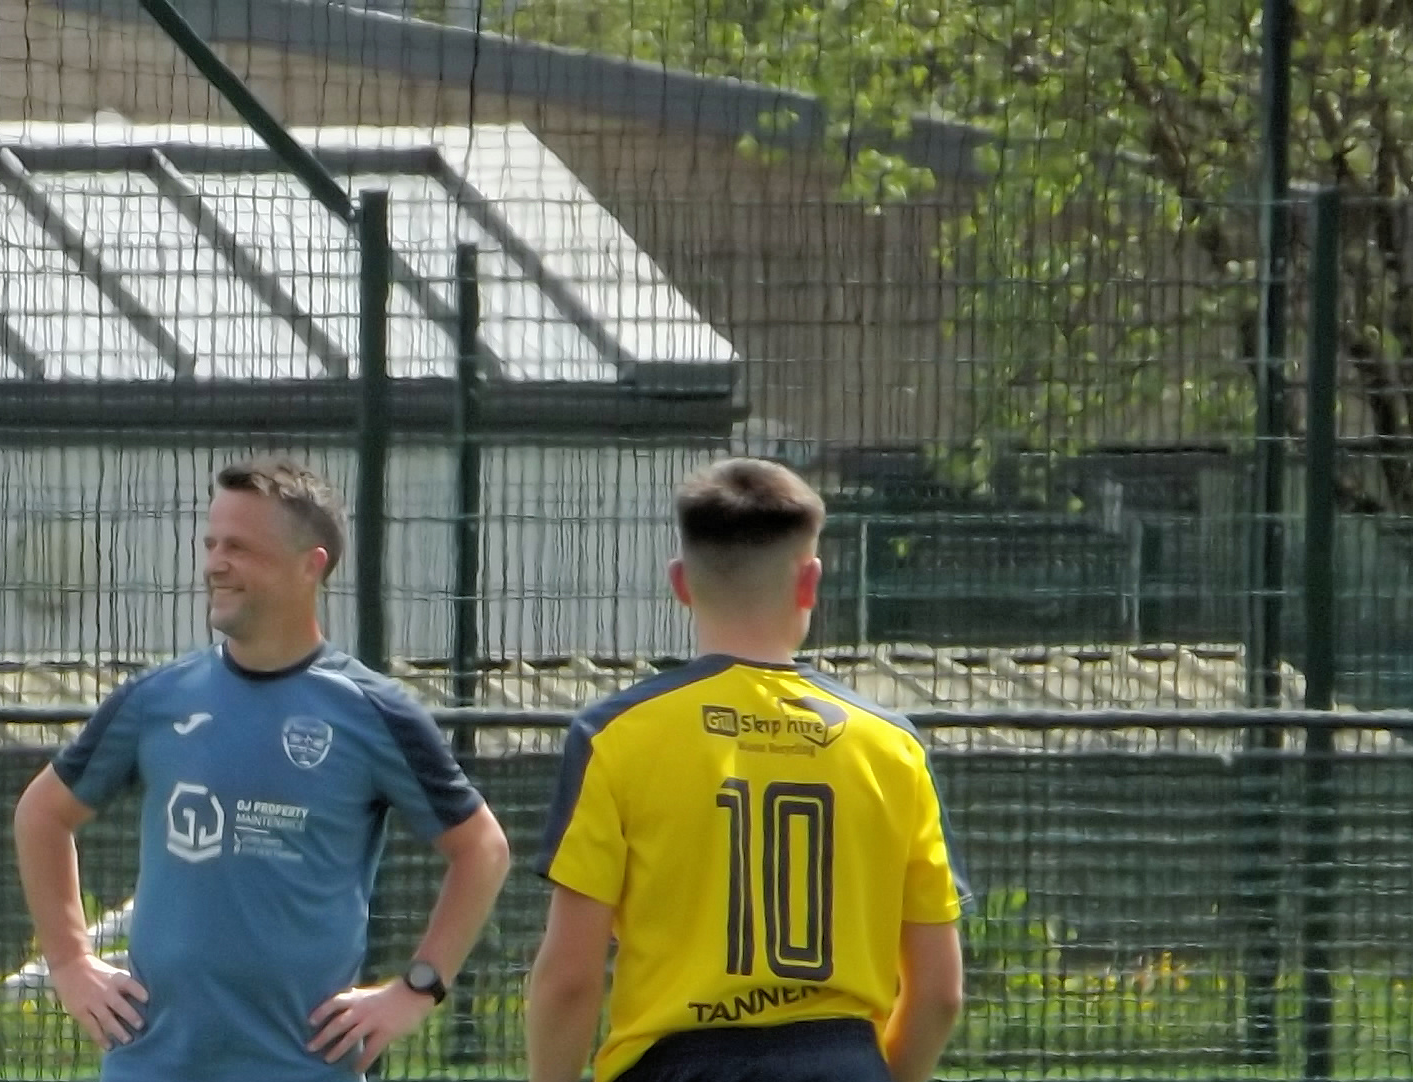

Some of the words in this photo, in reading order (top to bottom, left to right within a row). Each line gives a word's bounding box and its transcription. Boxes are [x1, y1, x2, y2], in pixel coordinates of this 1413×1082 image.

[741, 714, 781, 738] Skip
[254, 801, 309, 819] PROPERTY
[716, 777, 835, 981] 10
